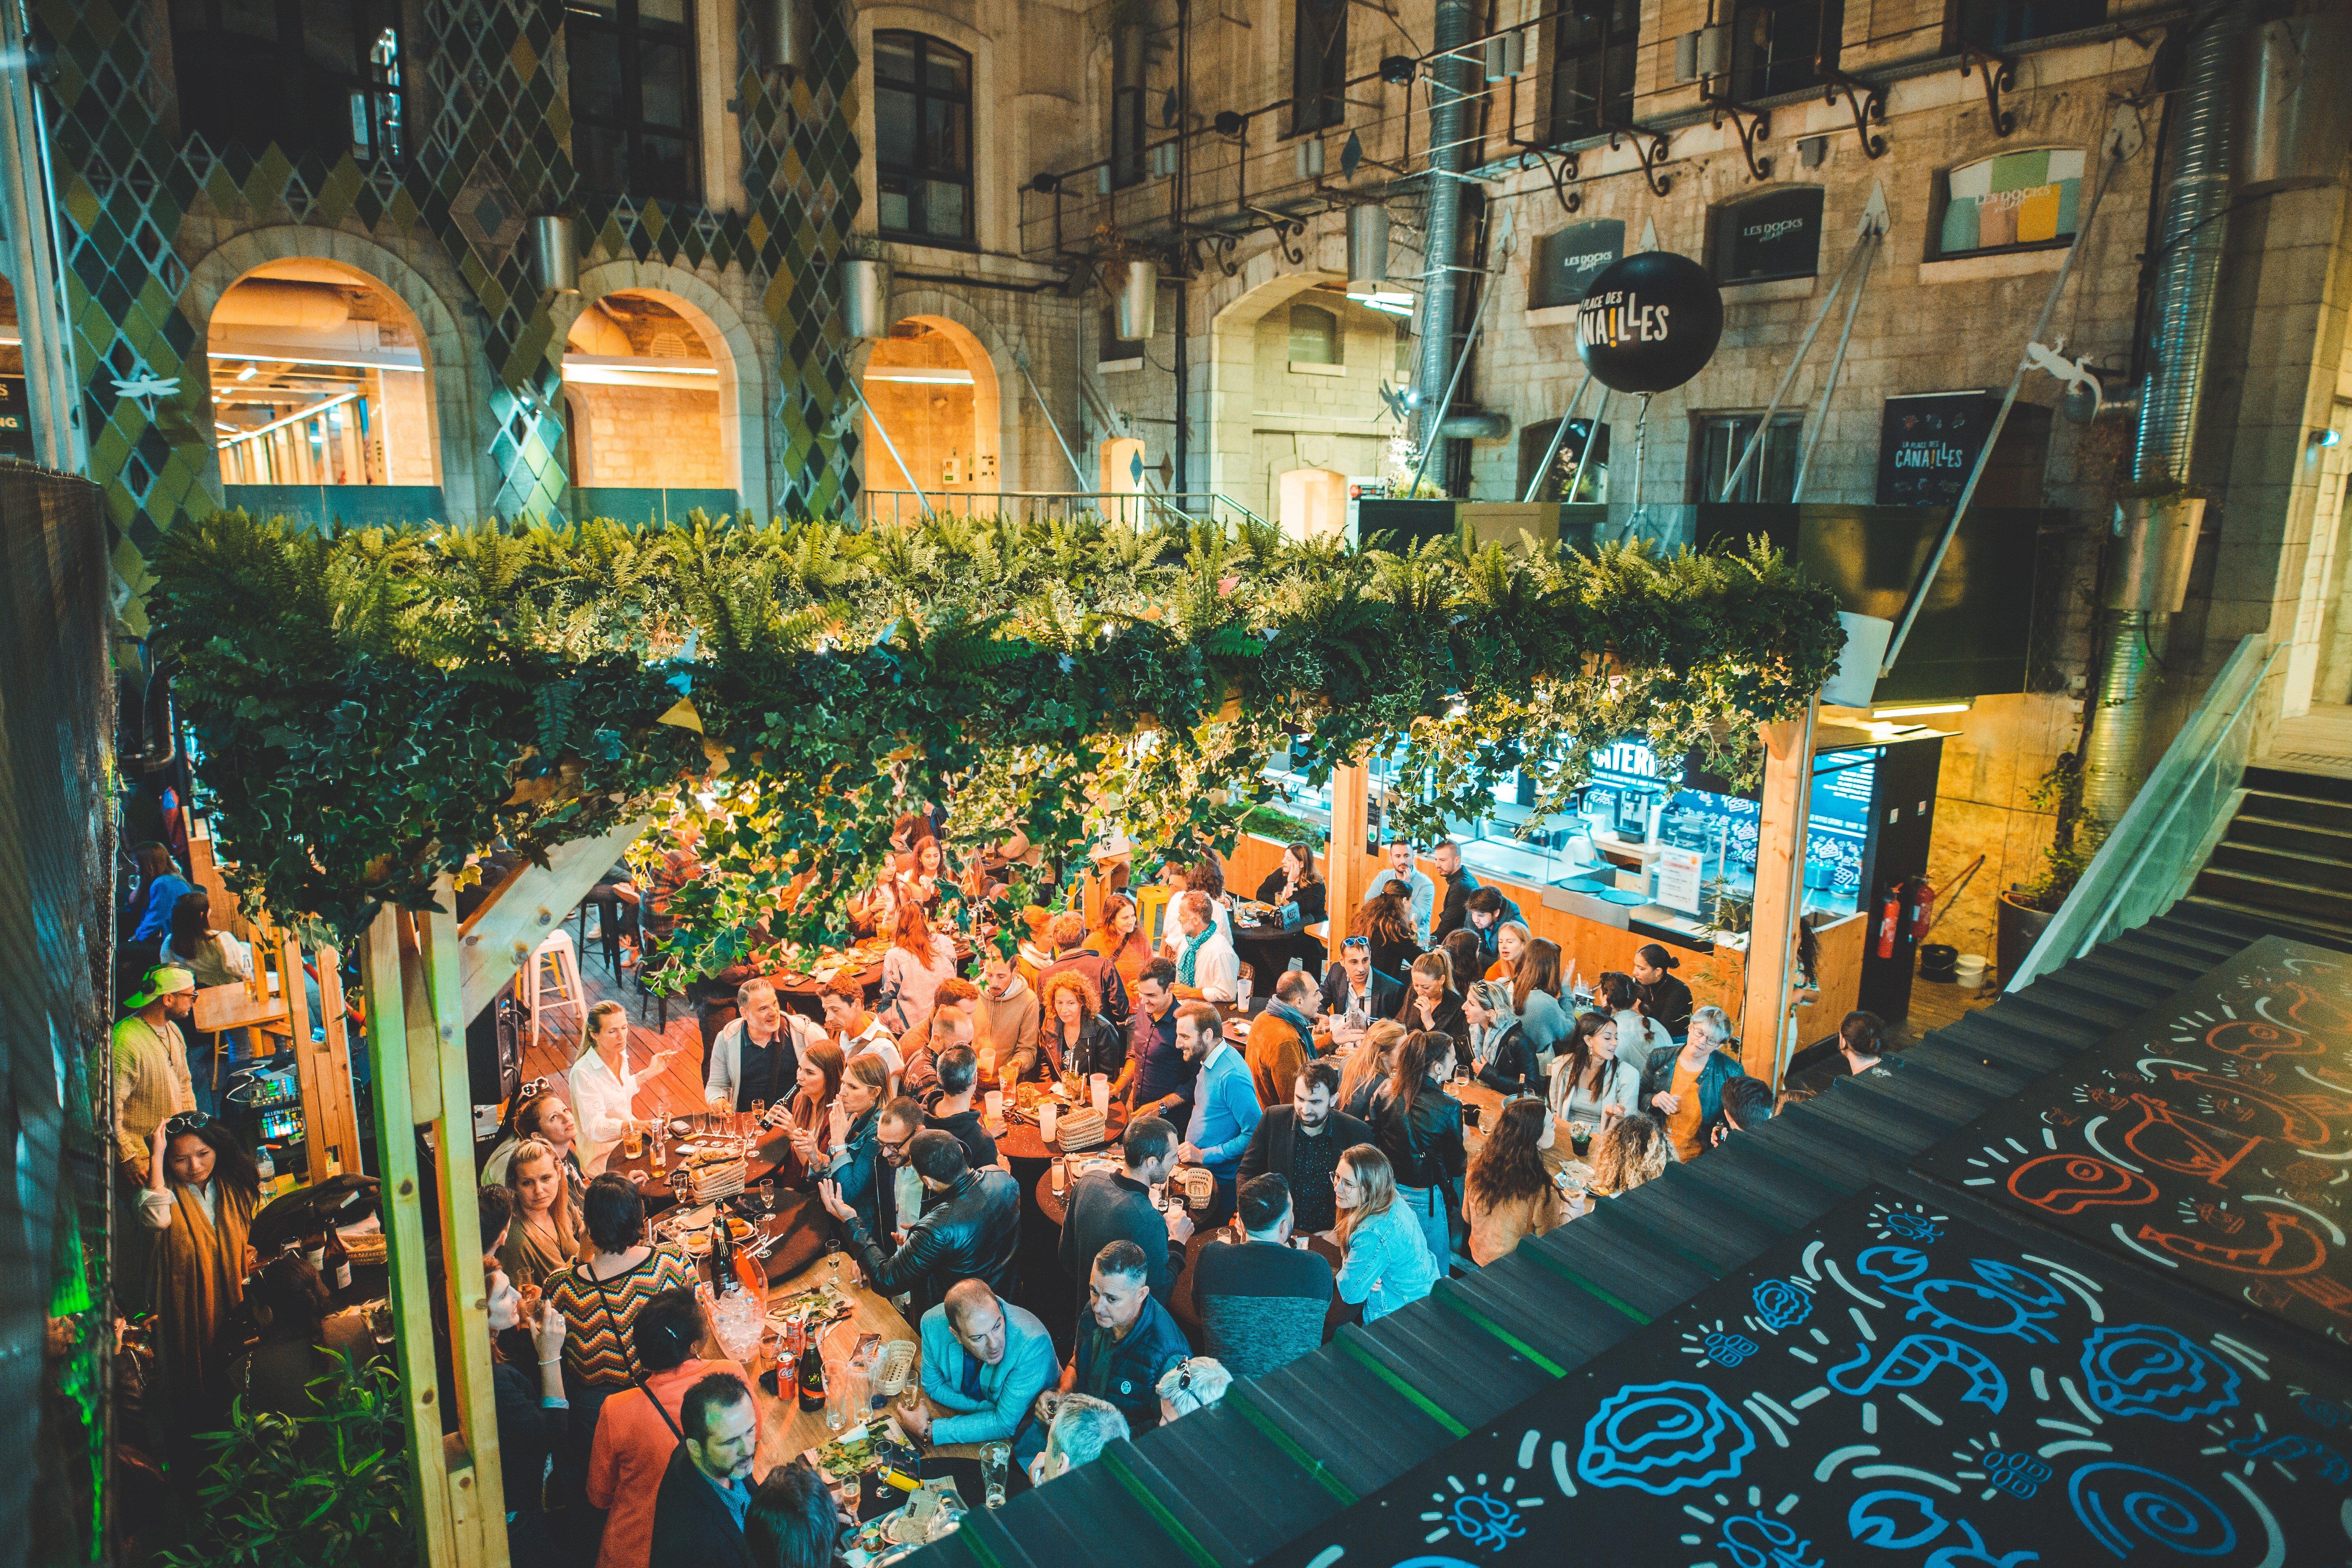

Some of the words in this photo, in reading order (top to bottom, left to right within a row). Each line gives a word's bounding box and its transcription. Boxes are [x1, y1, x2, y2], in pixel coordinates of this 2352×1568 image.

[1744, 225, 1762, 236] LES
[1764, 218, 1802, 234] DOCKS
[1564, 256, 1579, 266] LES
[1580, 251, 1612, 264] DOCKS
[1605, 291, 1623, 305] DES
